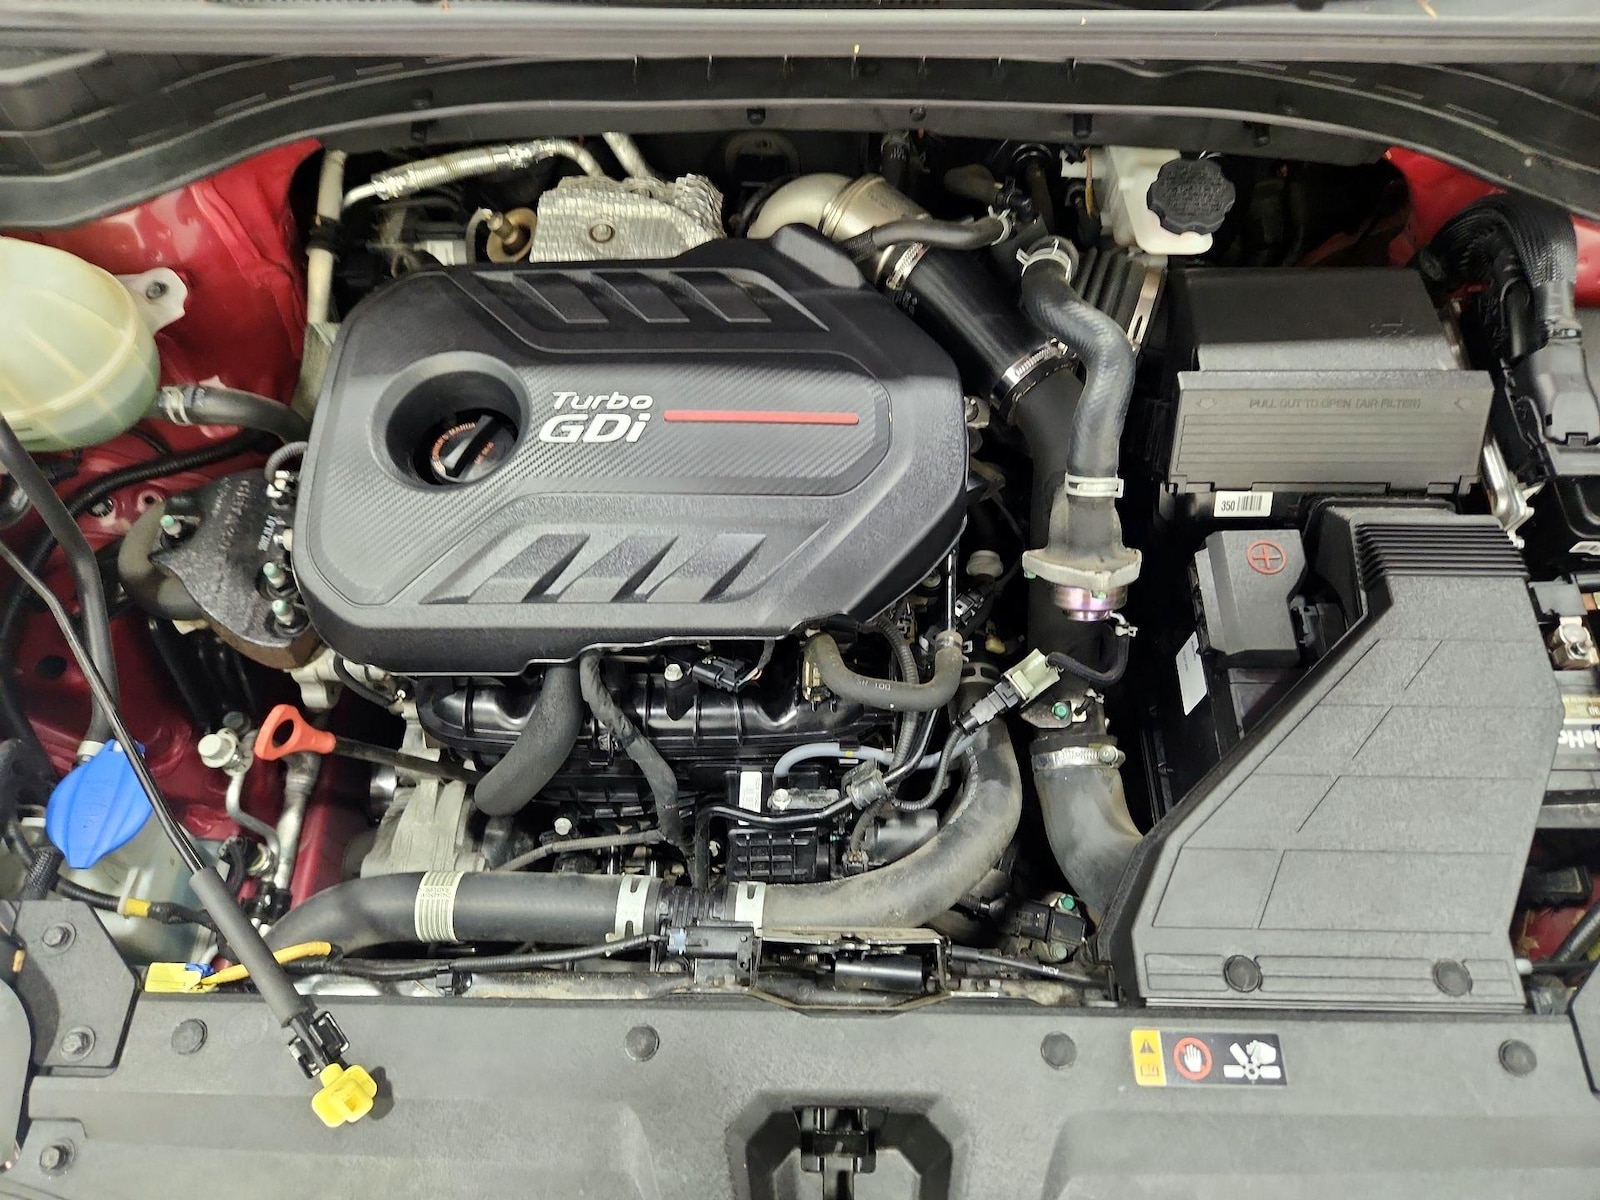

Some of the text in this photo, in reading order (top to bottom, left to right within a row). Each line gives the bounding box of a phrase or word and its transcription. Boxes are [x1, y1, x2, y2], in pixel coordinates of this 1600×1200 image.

[552, 391, 653, 410] Turbo
[1249, 398, 1277, 409] PULL
[1279, 398, 1302, 409] OUT
[1305, 398, 1320, 409] TO
[1320, 398, 1352, 409] OPEN
[539, 413, 651, 443] GDi
[1221, 500, 1236, 511] 350
